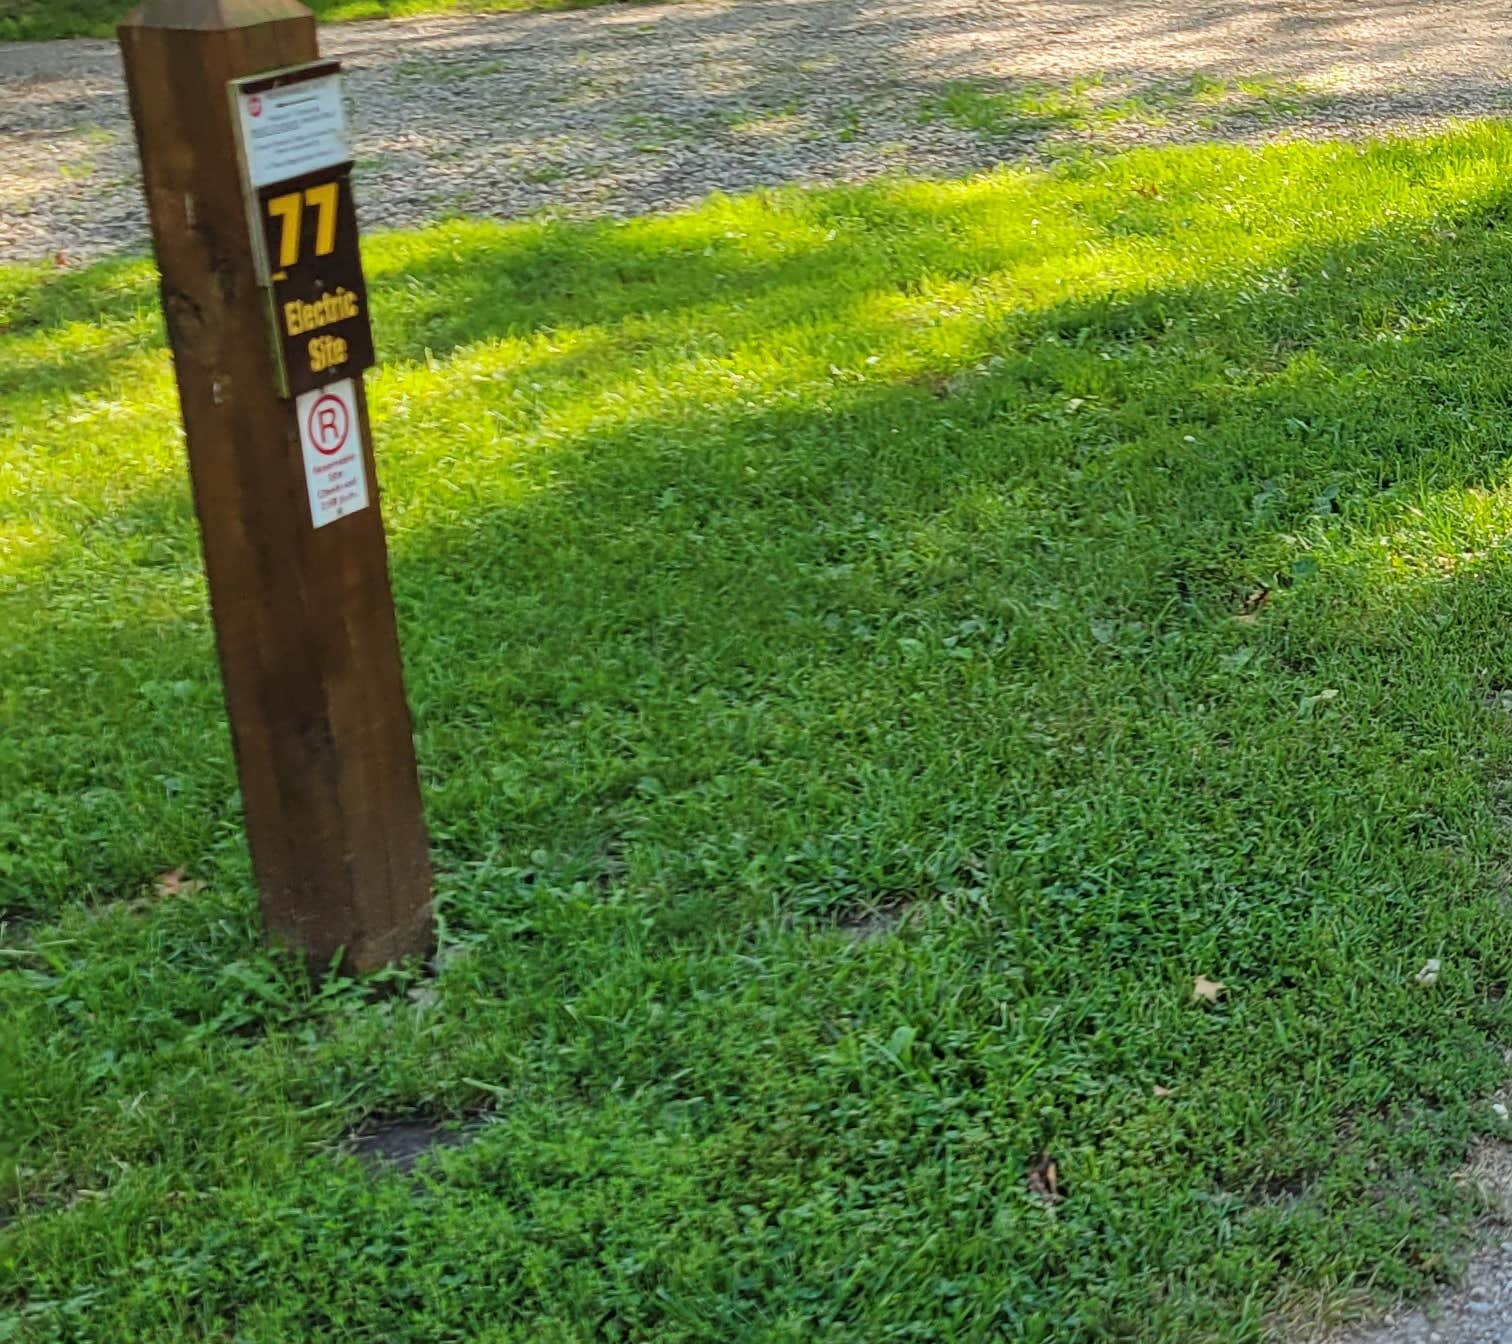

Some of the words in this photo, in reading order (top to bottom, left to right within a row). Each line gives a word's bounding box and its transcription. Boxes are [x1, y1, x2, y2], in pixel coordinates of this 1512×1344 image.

[268, 182, 339, 267] 77
[284, 286, 359, 336] Electric
[308, 335, 348, 373] Site
[319, 408, 339, 443] R
